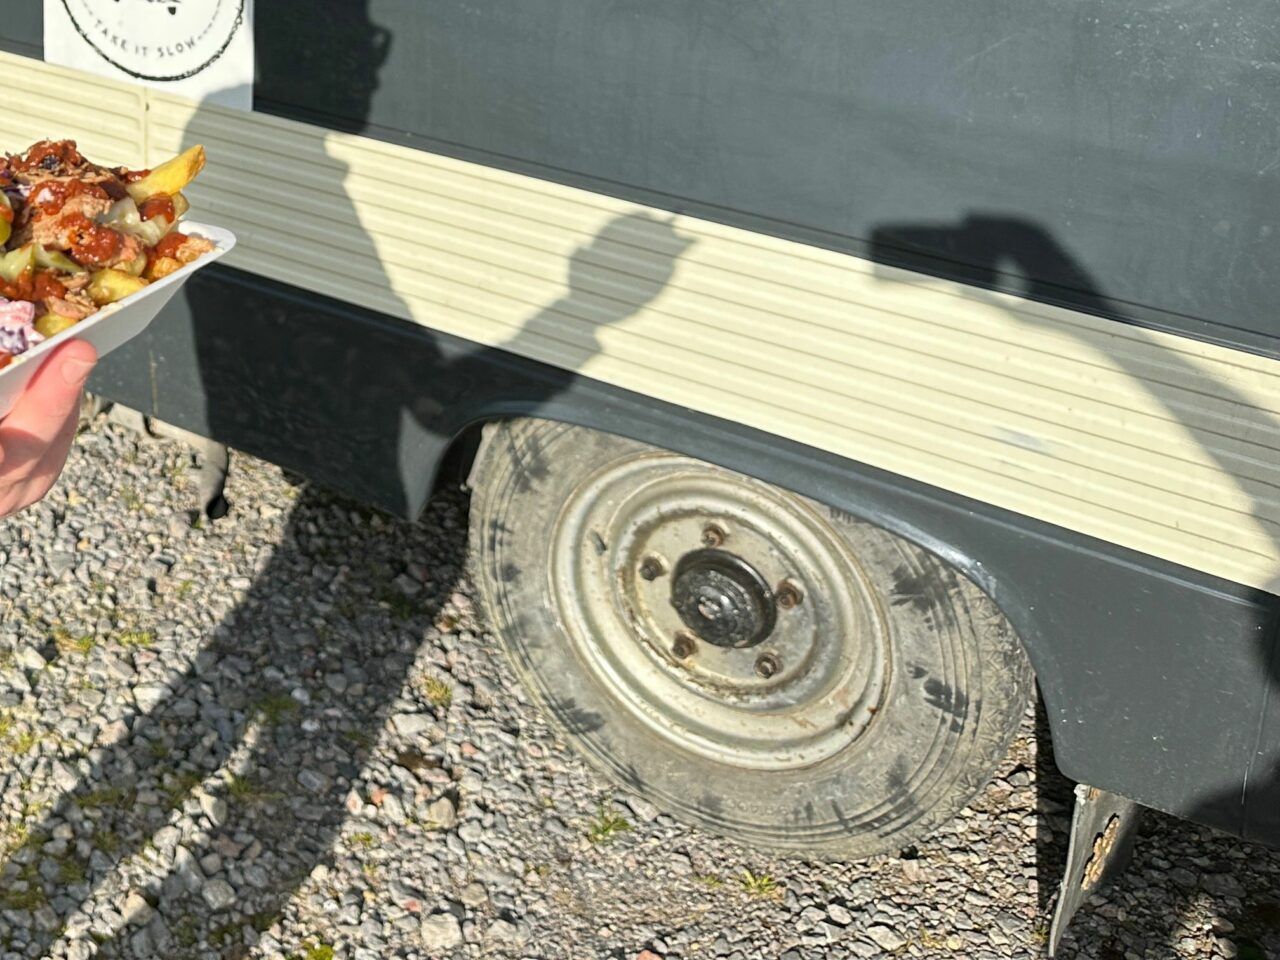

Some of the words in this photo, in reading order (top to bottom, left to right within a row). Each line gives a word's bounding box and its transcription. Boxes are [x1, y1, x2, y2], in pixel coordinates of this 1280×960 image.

[93, 19, 127, 53] TAKE
[134, 46, 148, 57] IT
[157, 38, 197, 59] SLOW
